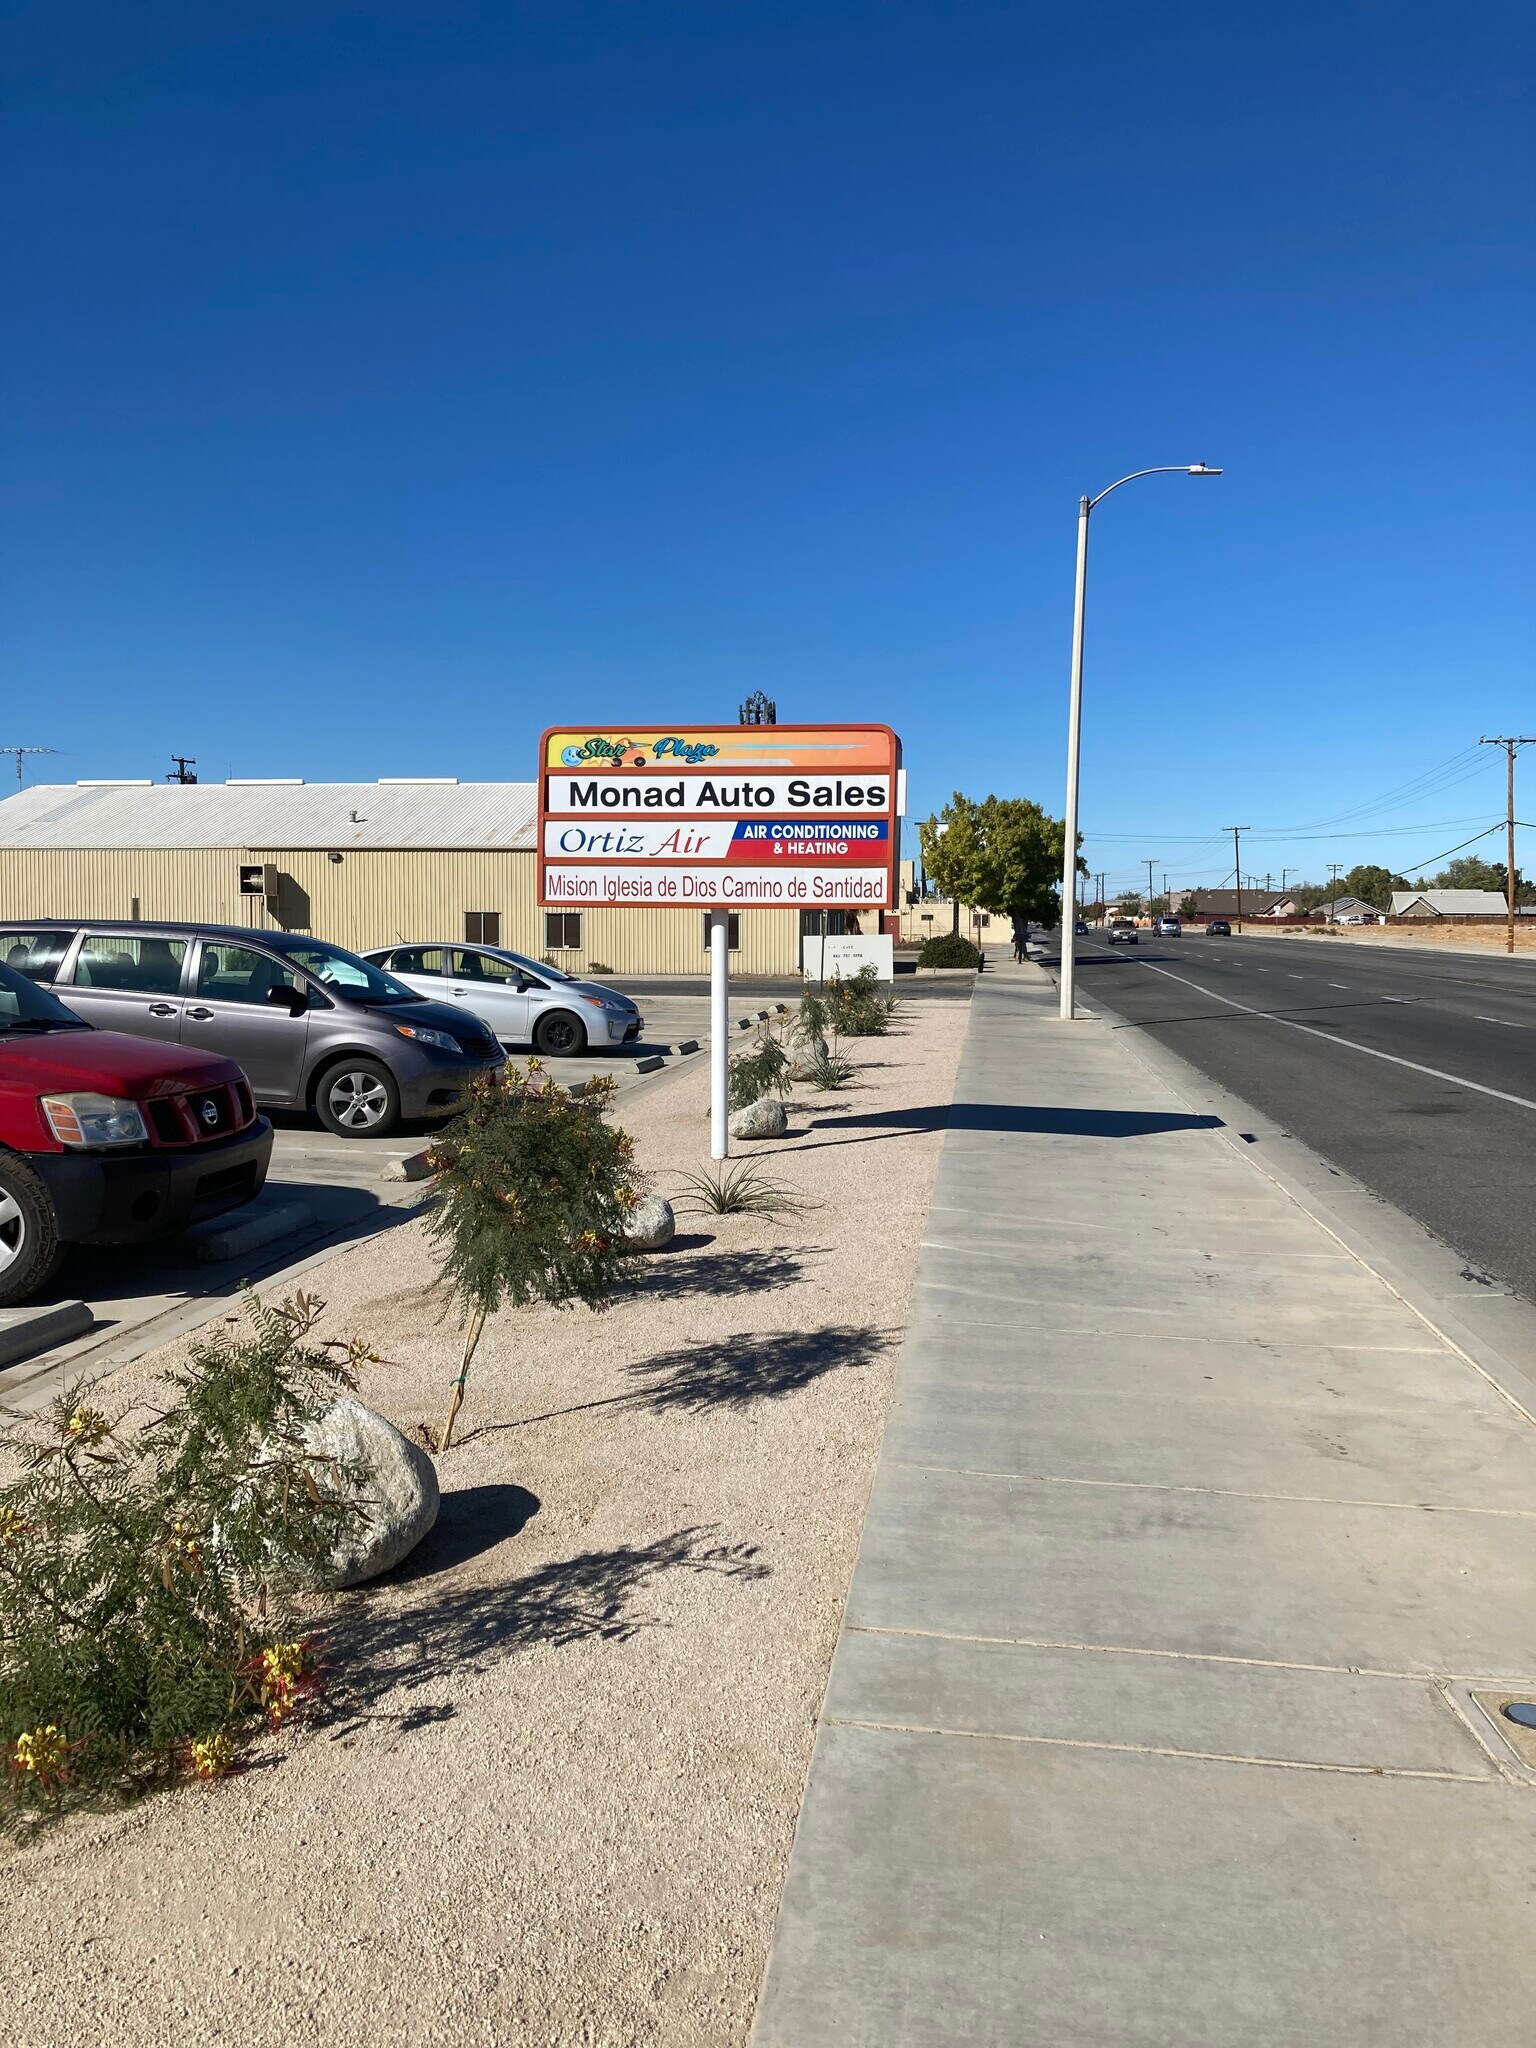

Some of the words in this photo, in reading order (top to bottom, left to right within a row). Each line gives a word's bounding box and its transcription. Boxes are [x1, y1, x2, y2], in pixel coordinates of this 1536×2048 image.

[578, 738, 627, 759] Star
[652, 737, 720, 763] Plaza
[570, 781, 684, 807] Monad
[696, 781, 775, 807] Auto
[788, 780, 886, 807] Sales
[560, 828, 645, 853] Ortiz
[649, 828, 711, 856] Air
[743, 825, 767, 839] AIR
[771, 825, 879, 839] CONDITIONING
[773, 842, 783, 854] &
[788, 842, 848, 854] HEATING
[549, 875, 597, 896] Mision
[603, 875, 652, 901] Iglesia
[658, 875, 677, 897] de
[683, 875, 717, 897] Dios
[722, 876, 782, 897] Camino
[788, 876, 807, 898] de
[813, 876, 883, 898] Santidad
